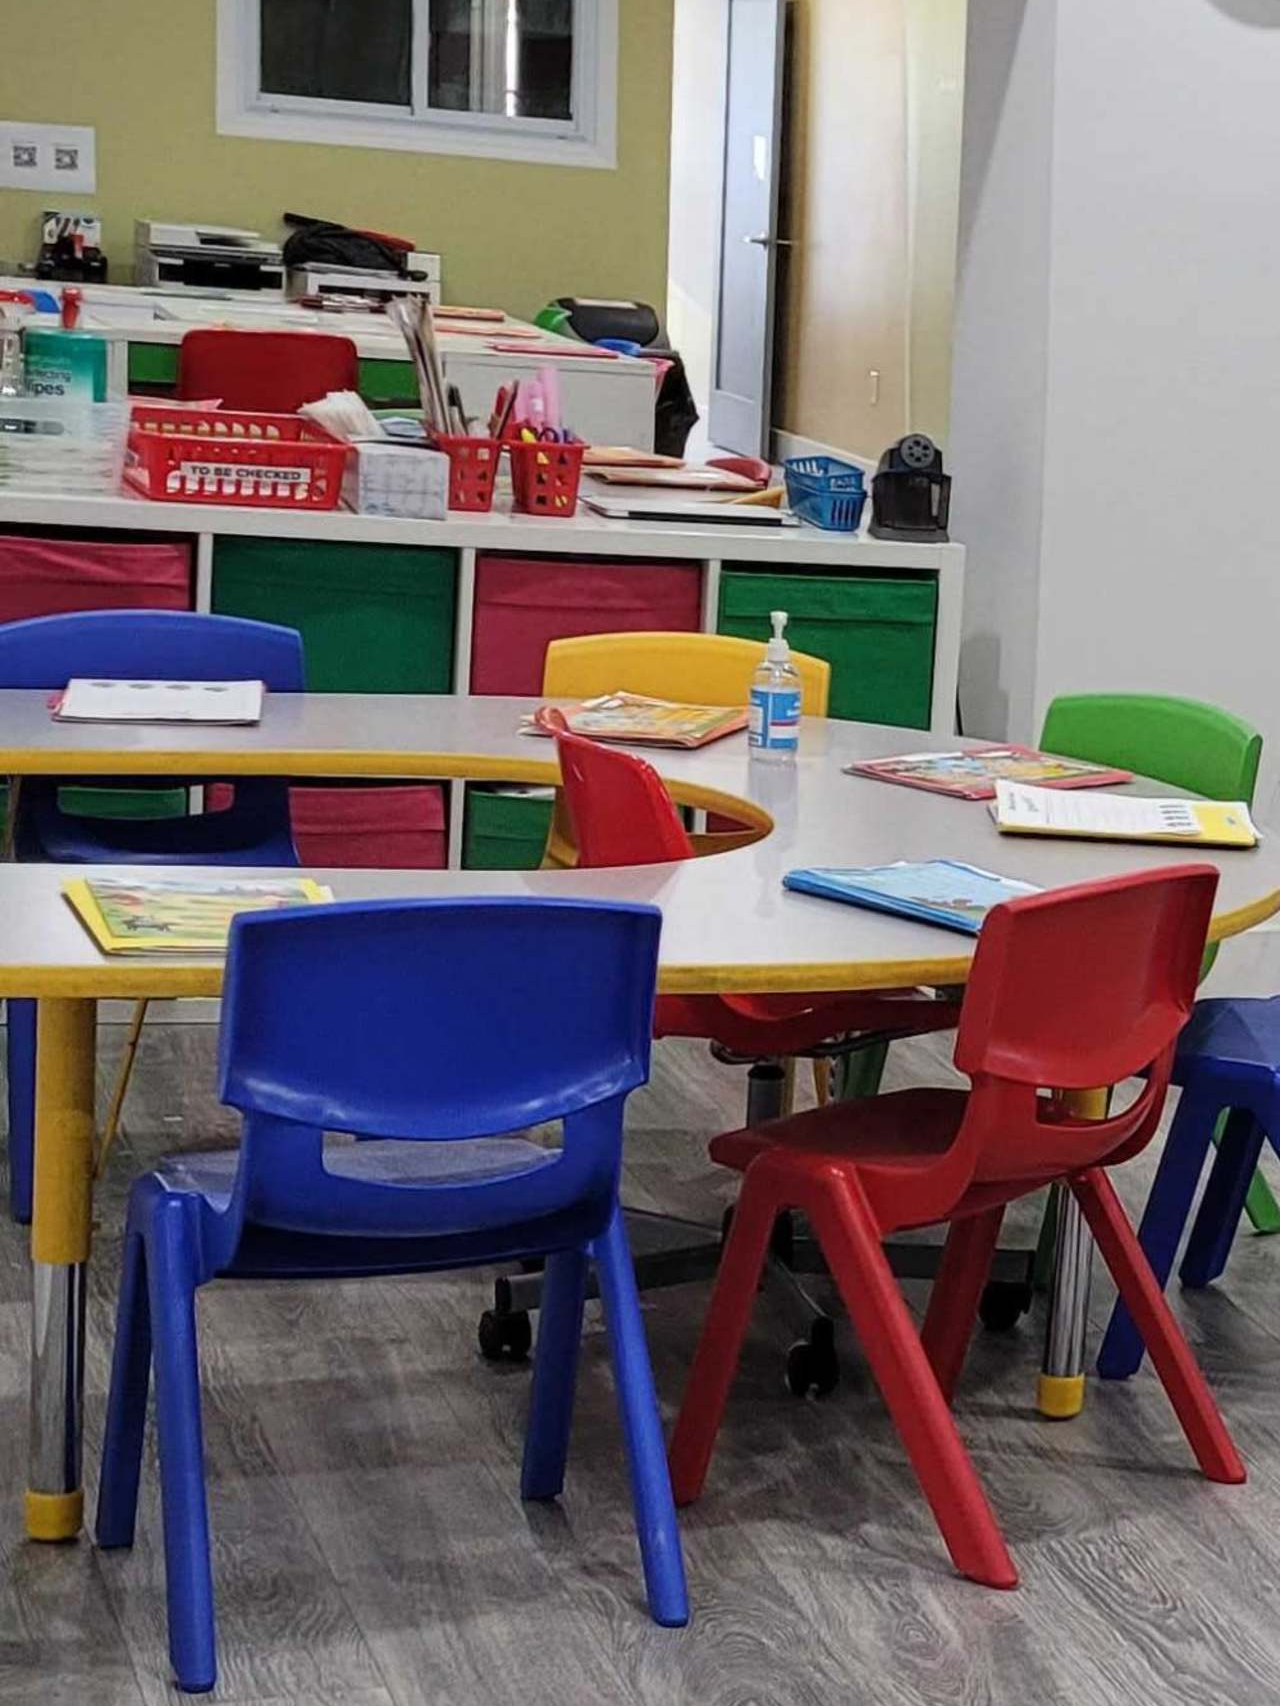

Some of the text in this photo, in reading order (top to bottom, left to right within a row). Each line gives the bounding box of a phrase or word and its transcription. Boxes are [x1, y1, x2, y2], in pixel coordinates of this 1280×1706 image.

[191, 466, 301, 480] TO BE CHECKED
